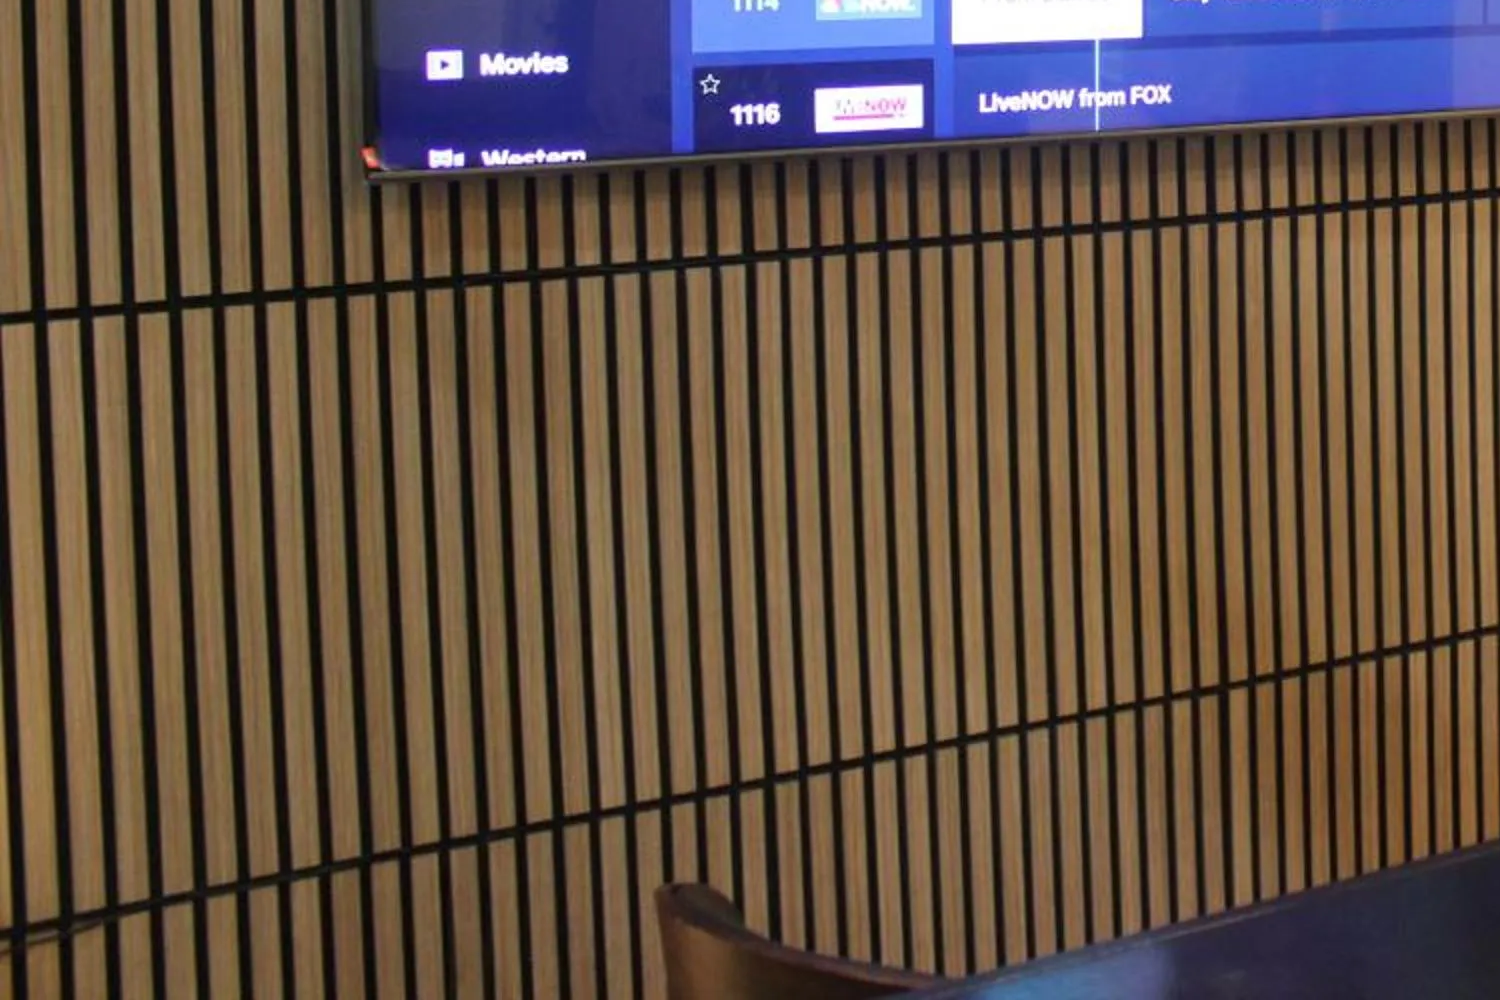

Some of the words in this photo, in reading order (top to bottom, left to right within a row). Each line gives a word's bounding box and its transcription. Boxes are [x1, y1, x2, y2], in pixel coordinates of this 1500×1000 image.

[479, 50, 570, 77] Movies
[978, 89, 1074, 115] LiveNOW
[1077, 86, 1127, 112] from
[1129, 83, 1173, 107] FOX
[729, 102, 782, 127] 1116
